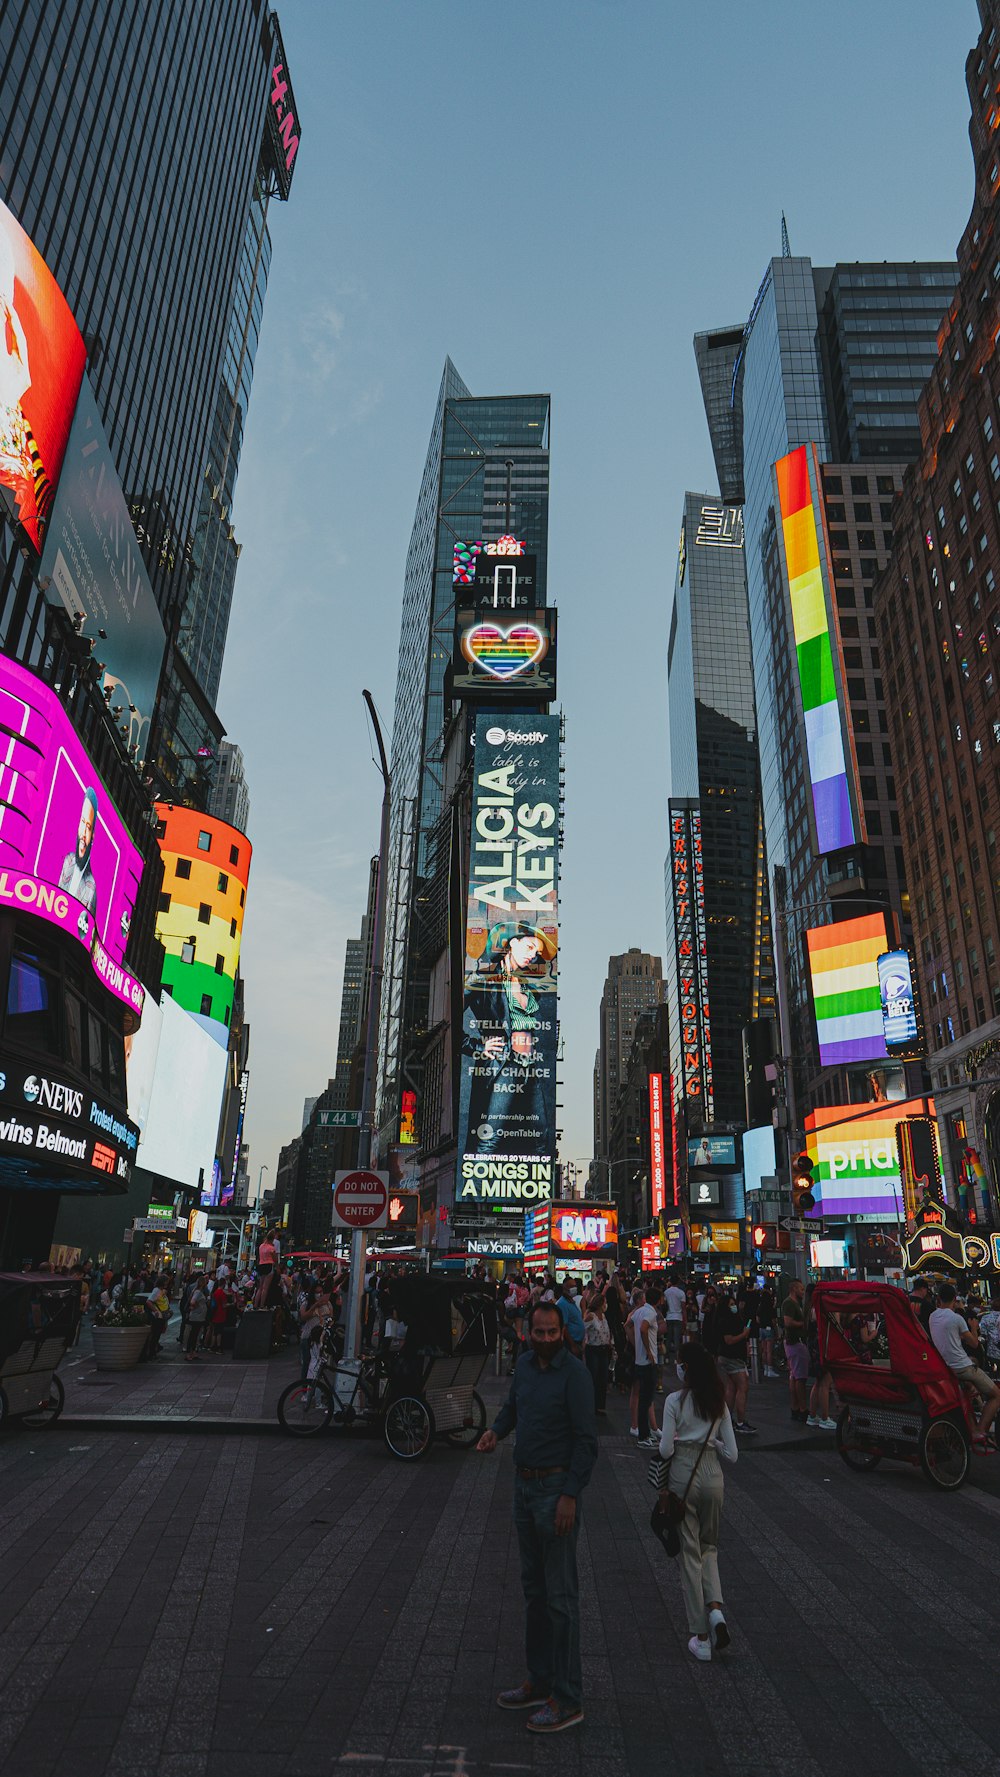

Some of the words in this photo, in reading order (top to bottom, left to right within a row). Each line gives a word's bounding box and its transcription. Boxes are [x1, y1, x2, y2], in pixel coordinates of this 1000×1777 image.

[487, 543, 521, 556] 2021
[507, 731, 548, 744] Spotify
[491, 754, 525, 767] table
[528, 757, 540, 767] is
[531, 776, 547, 786] in
[473, 764, 516, 911] ALICIA
[515, 802, 556, 911] KEYS
[674, 818, 689, 917] ERNST
[0, 872, 69, 919] LONG
[106, 961, 124, 991] FUN
[886, 997, 911, 1010] TACO
[888, 1004, 912, 1018] BELL
[469, 1019, 509, 1030] STELLA
[511, 1036, 540, 1046] HELP
[681, 978, 701, 1096] YOUNG
[468, 1066, 499, 1077] FIRST
[501, 1067, 551, 1078] CHALICE
[493, 1082, 525, 1094] BACK
[37, 1078, 83, 1118] NEWS
[89, 1101, 114, 1133] Protest
[320, 1112, 330, 1125] W
[332, 1112, 347, 1125] 44
[488, 1113, 525, 1121] partnership
[526, 1113, 540, 1121] with
[496, 1128, 541, 1138] OpenTable
[35, 1124, 87, 1160] Belmont
[91, 1141, 116, 1174] ESPN
[463, 1154, 509, 1162] CELEBRATING
[462, 1162, 529, 1180] SONGS
[532, 1164, 551, 1180] IN
[344, 1182, 358, 1191] DO
[360, 1182, 379, 1191] NOT
[461, 1179, 478, 1197] A
[481, 1180, 551, 1199] MINOR
[148, 1207, 173, 1217] BUCKS
[345, 1206, 375, 1216] ENTER
[561, 1215, 609, 1243] PART
[784, 1220, 797, 1228] ONE
[803, 1221, 818, 1229] WAY
[467, 1241, 489, 1253] NEW
[490, 1240, 513, 1254] YORK
